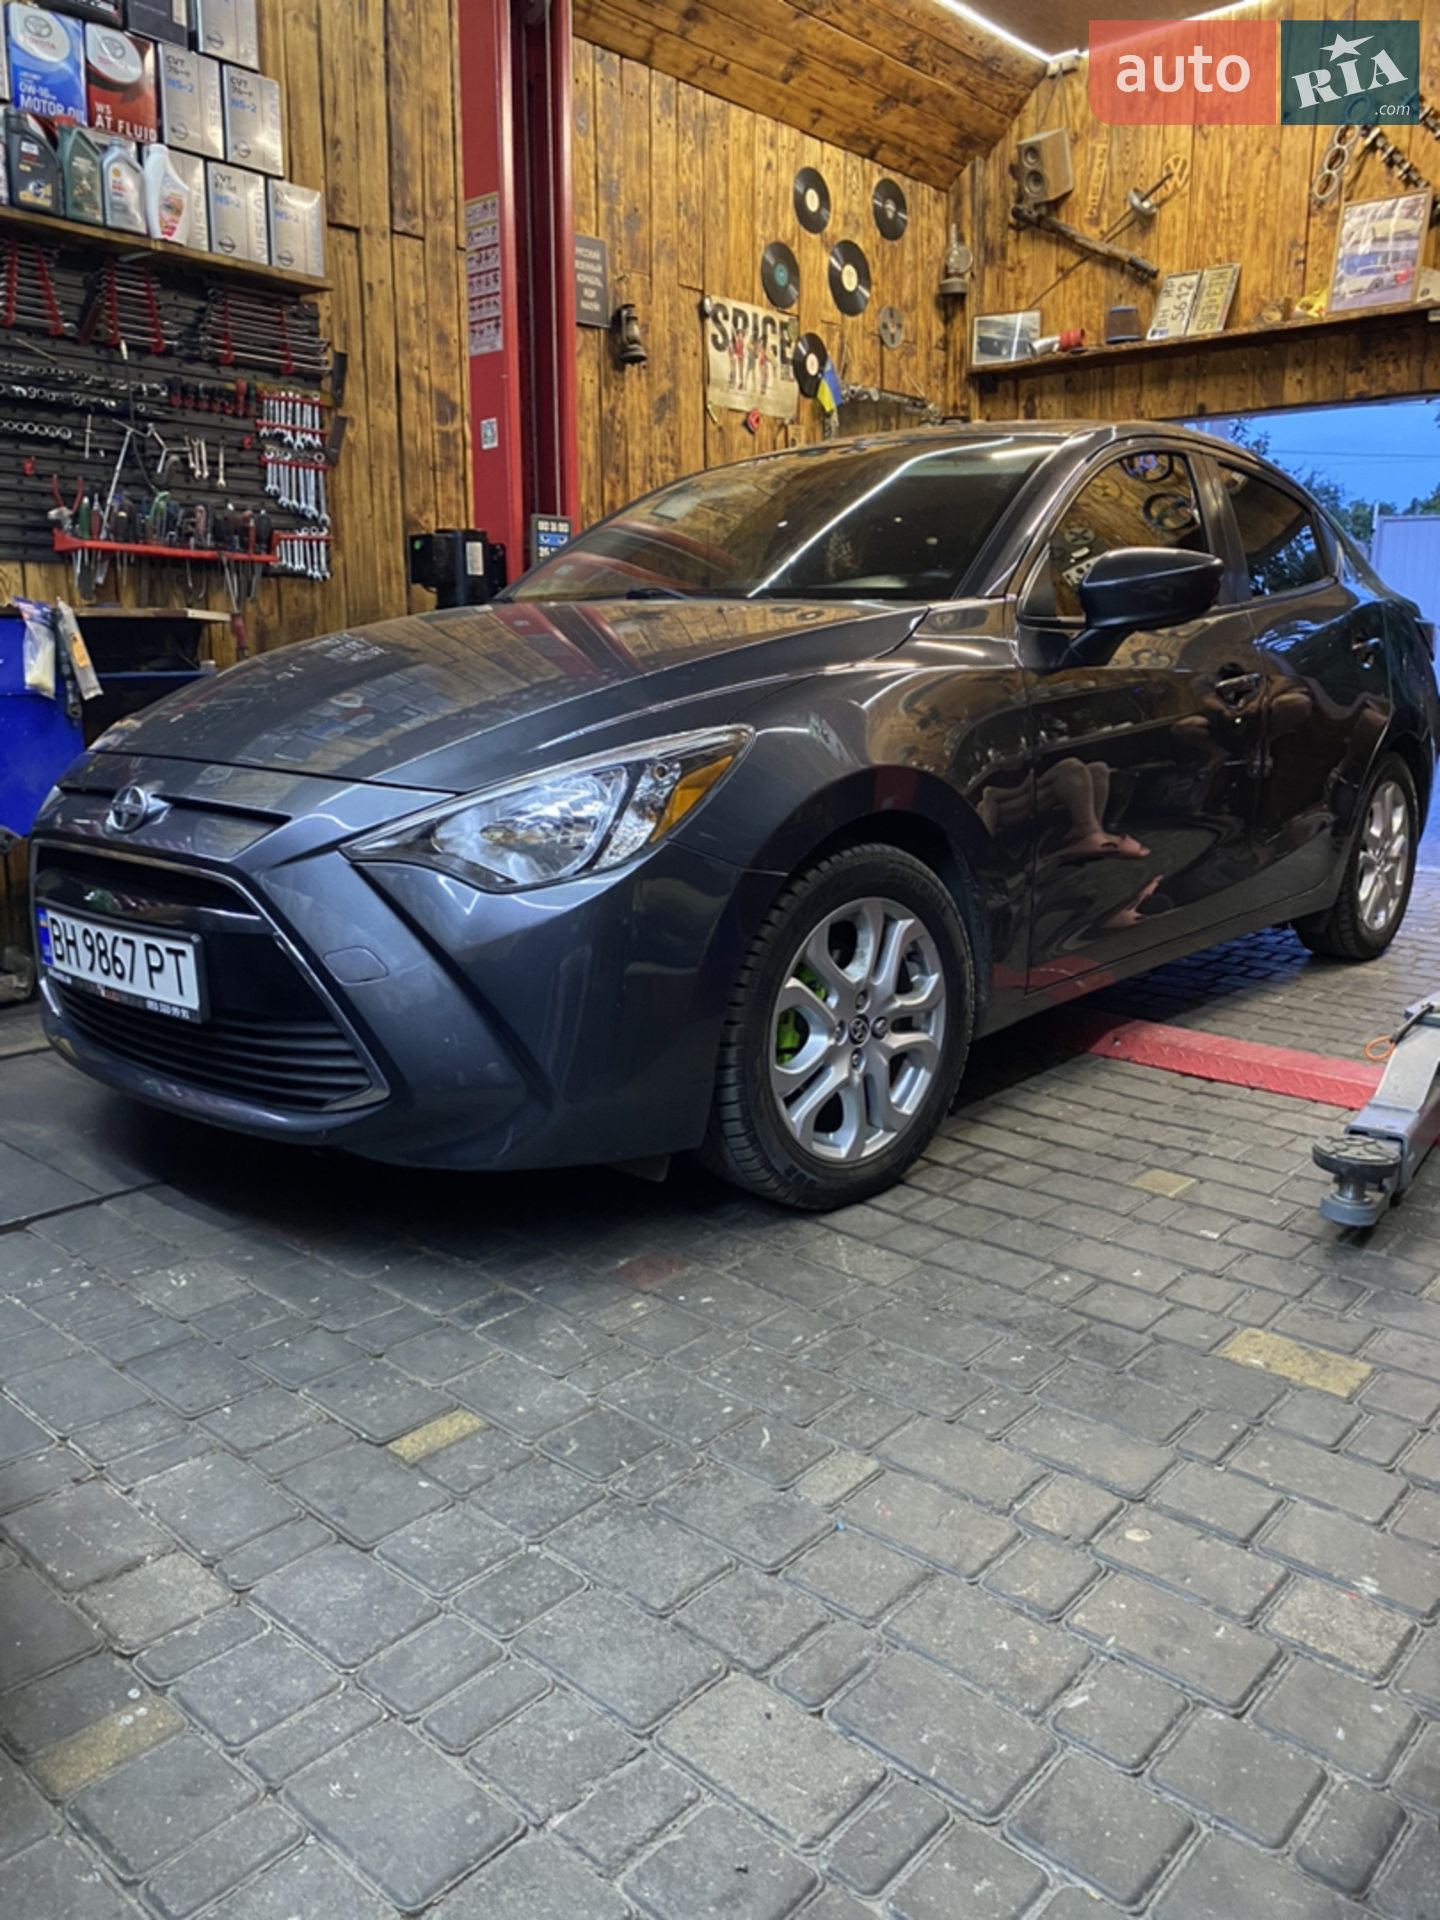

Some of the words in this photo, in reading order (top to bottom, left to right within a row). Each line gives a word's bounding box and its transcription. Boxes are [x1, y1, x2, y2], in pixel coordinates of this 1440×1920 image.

[166, 54, 185, 67] CVT
[165, 77, 195, 94] NS-2
[230, 76, 248, 89] CVT
[20, 95, 65, 116] MOTOR
[94, 101, 112, 115] WS
[230, 97, 258, 114] NS-2
[95, 116, 113, 130] AT
[117, 119, 158, 142] FLUID
[214, 194, 241, 209] NS-2
[1170, 281, 1194, 321] 5612
[710, 302, 795, 366] SPICE
[49, 917, 81, 969] BH
[82, 928, 136, 985] 9867
[144, 942, 187, 998] PT
